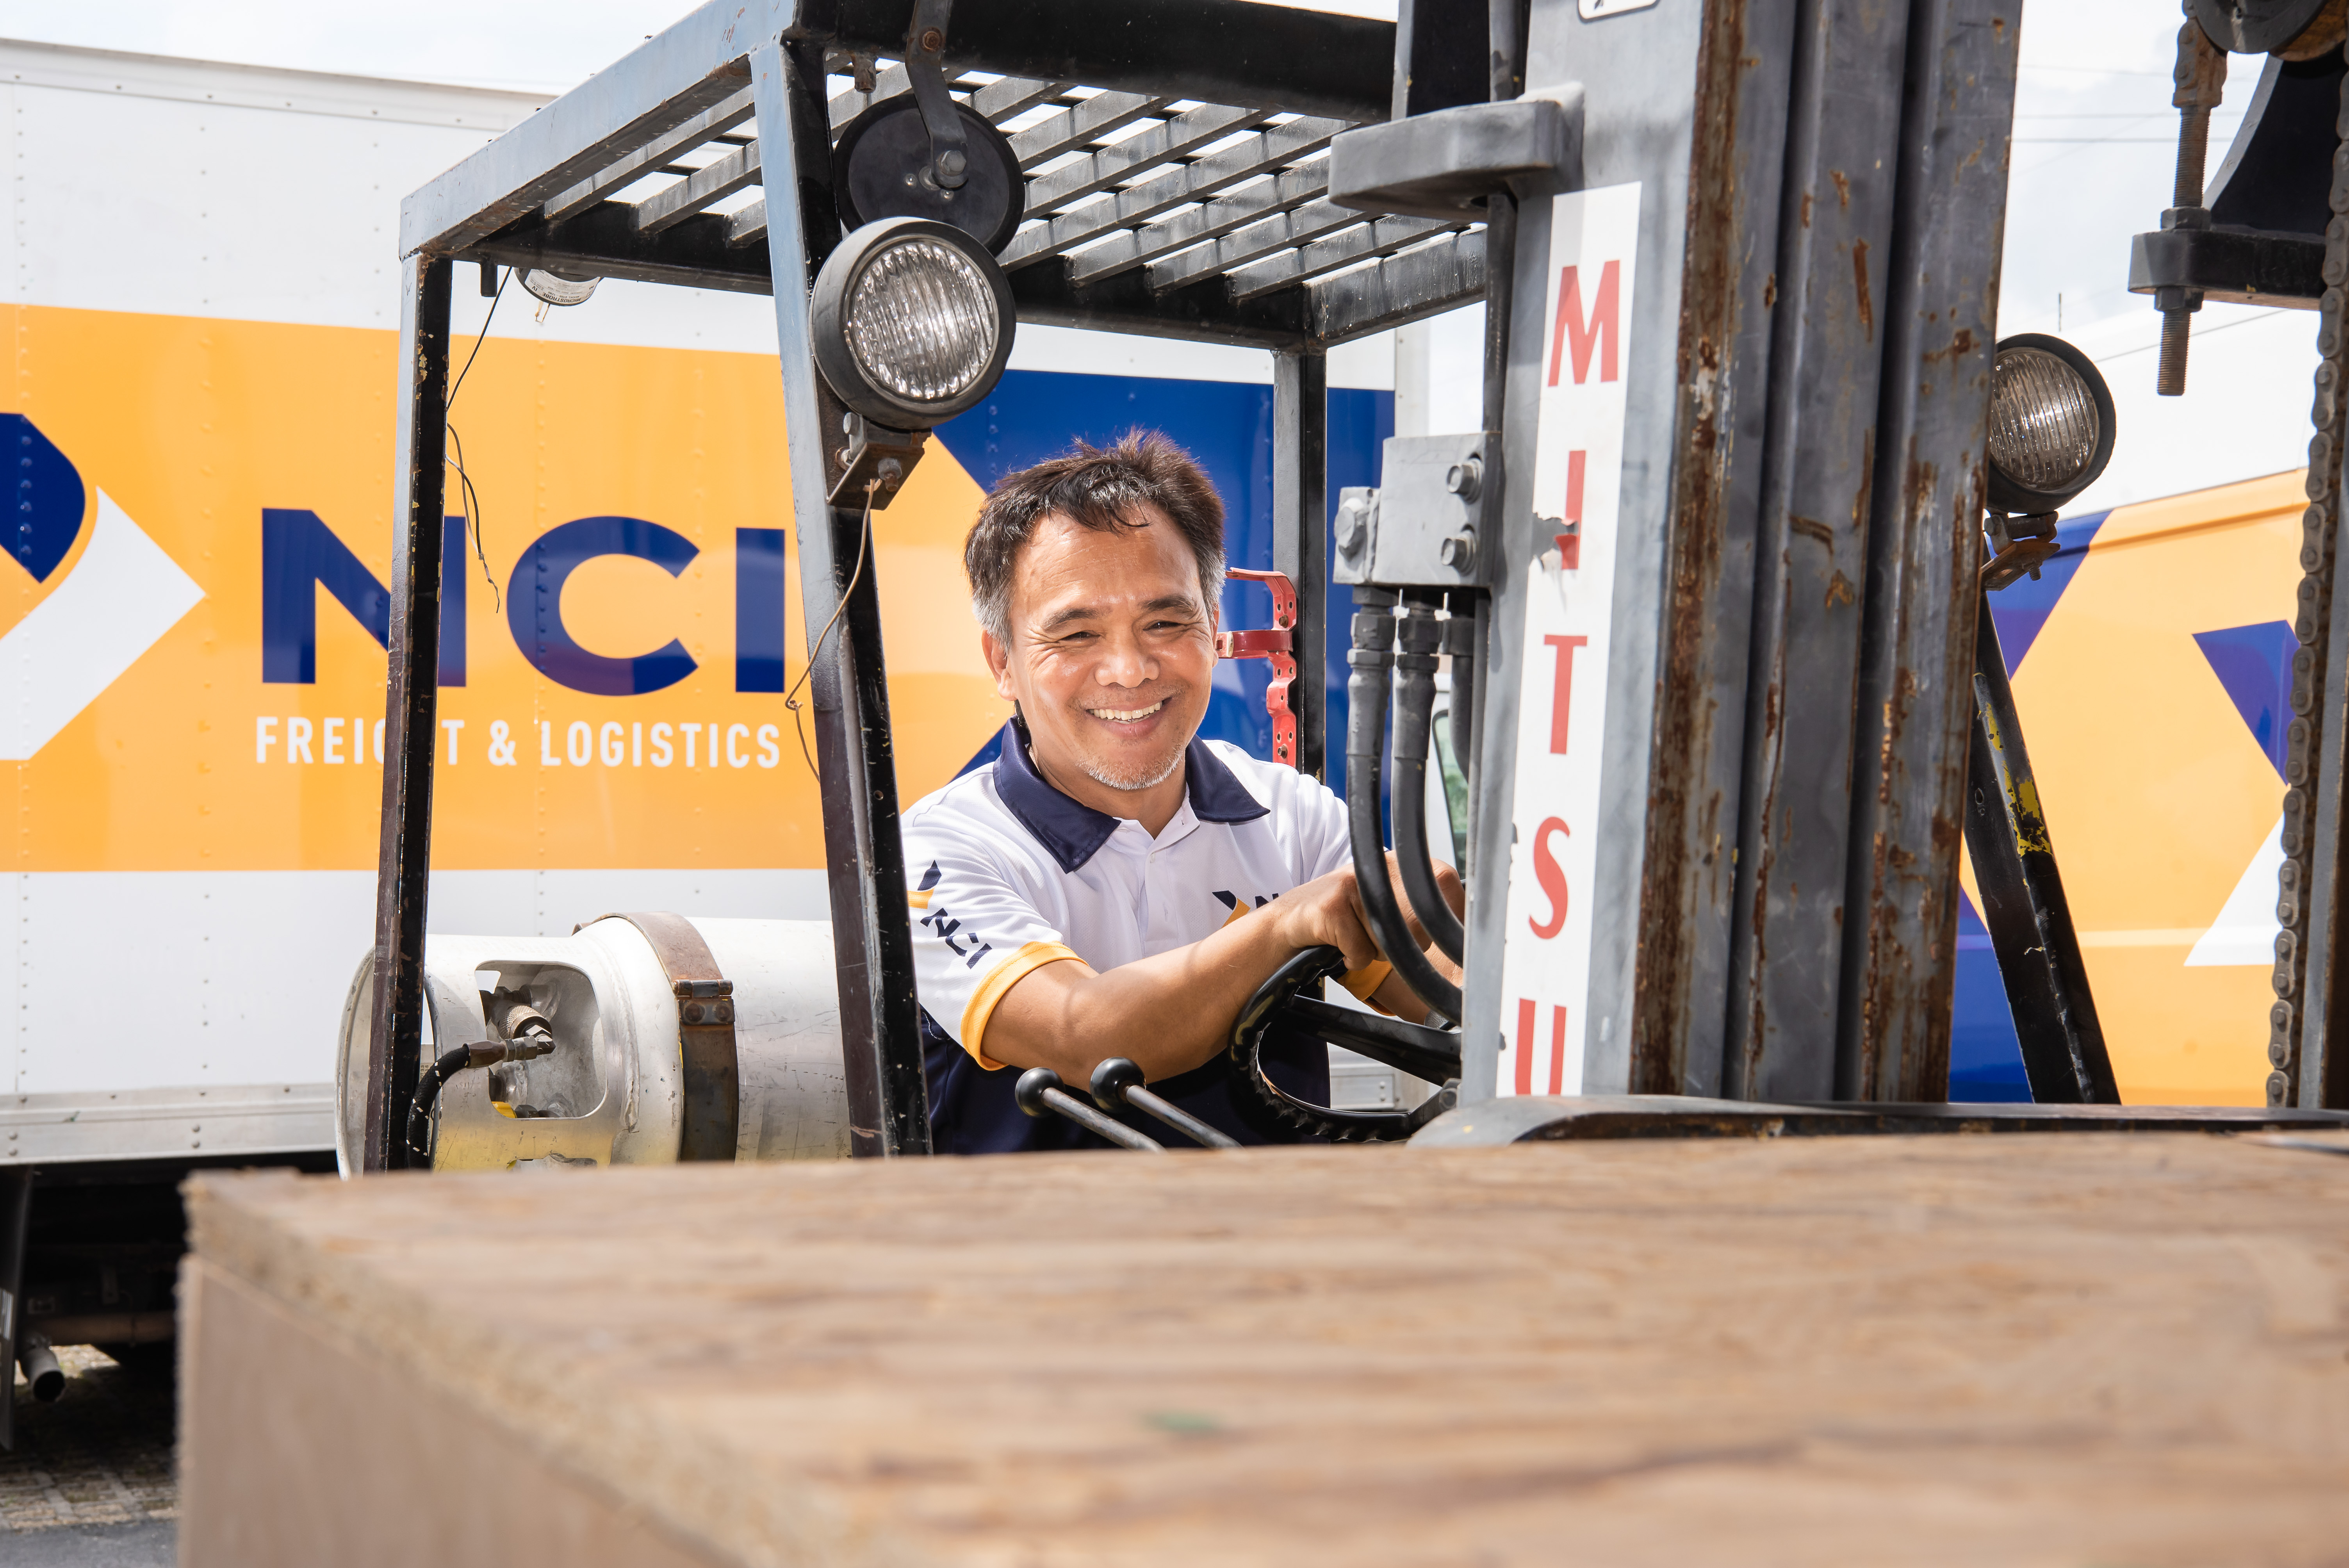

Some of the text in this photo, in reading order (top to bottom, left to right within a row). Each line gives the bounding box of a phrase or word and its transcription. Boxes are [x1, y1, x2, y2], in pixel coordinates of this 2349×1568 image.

[262, 508, 786, 696] NCI
[256, 716, 781, 769] FREIT & LOGISTICS
